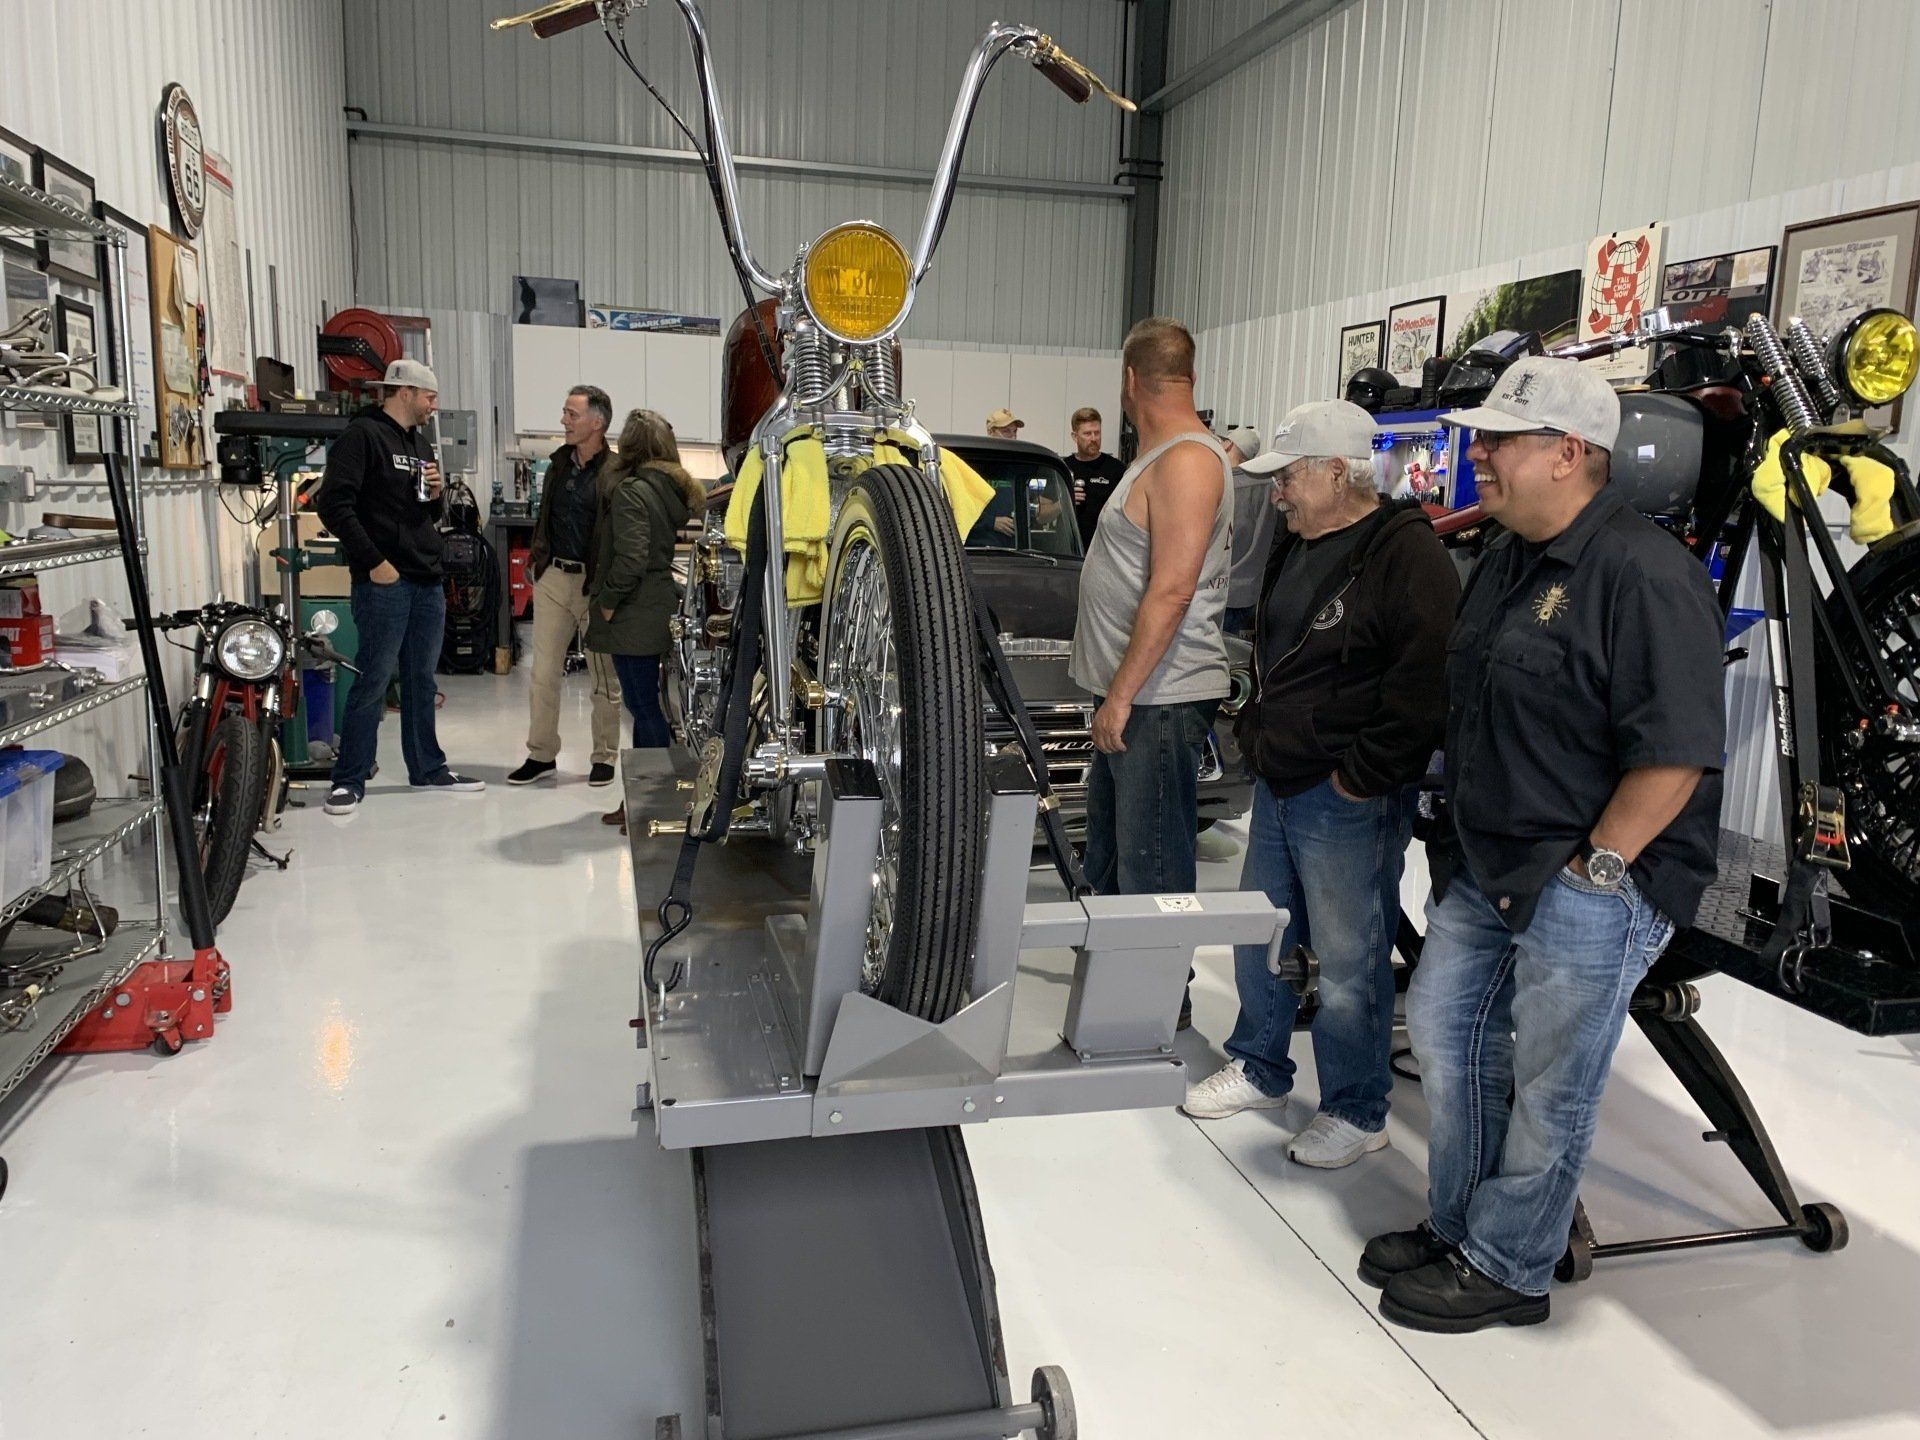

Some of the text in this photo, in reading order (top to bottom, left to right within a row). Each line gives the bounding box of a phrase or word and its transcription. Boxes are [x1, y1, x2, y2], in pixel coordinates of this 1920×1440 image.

[185, 162, 201, 205] 66
[1613, 290, 1628, 298] NOW
[1662, 288, 1732, 302] OTTE
[629, 319, 659, 329] SHARK
[1348, 331, 1375, 347] HUNTER
[1778, 688, 1795, 757] BikeMaster
